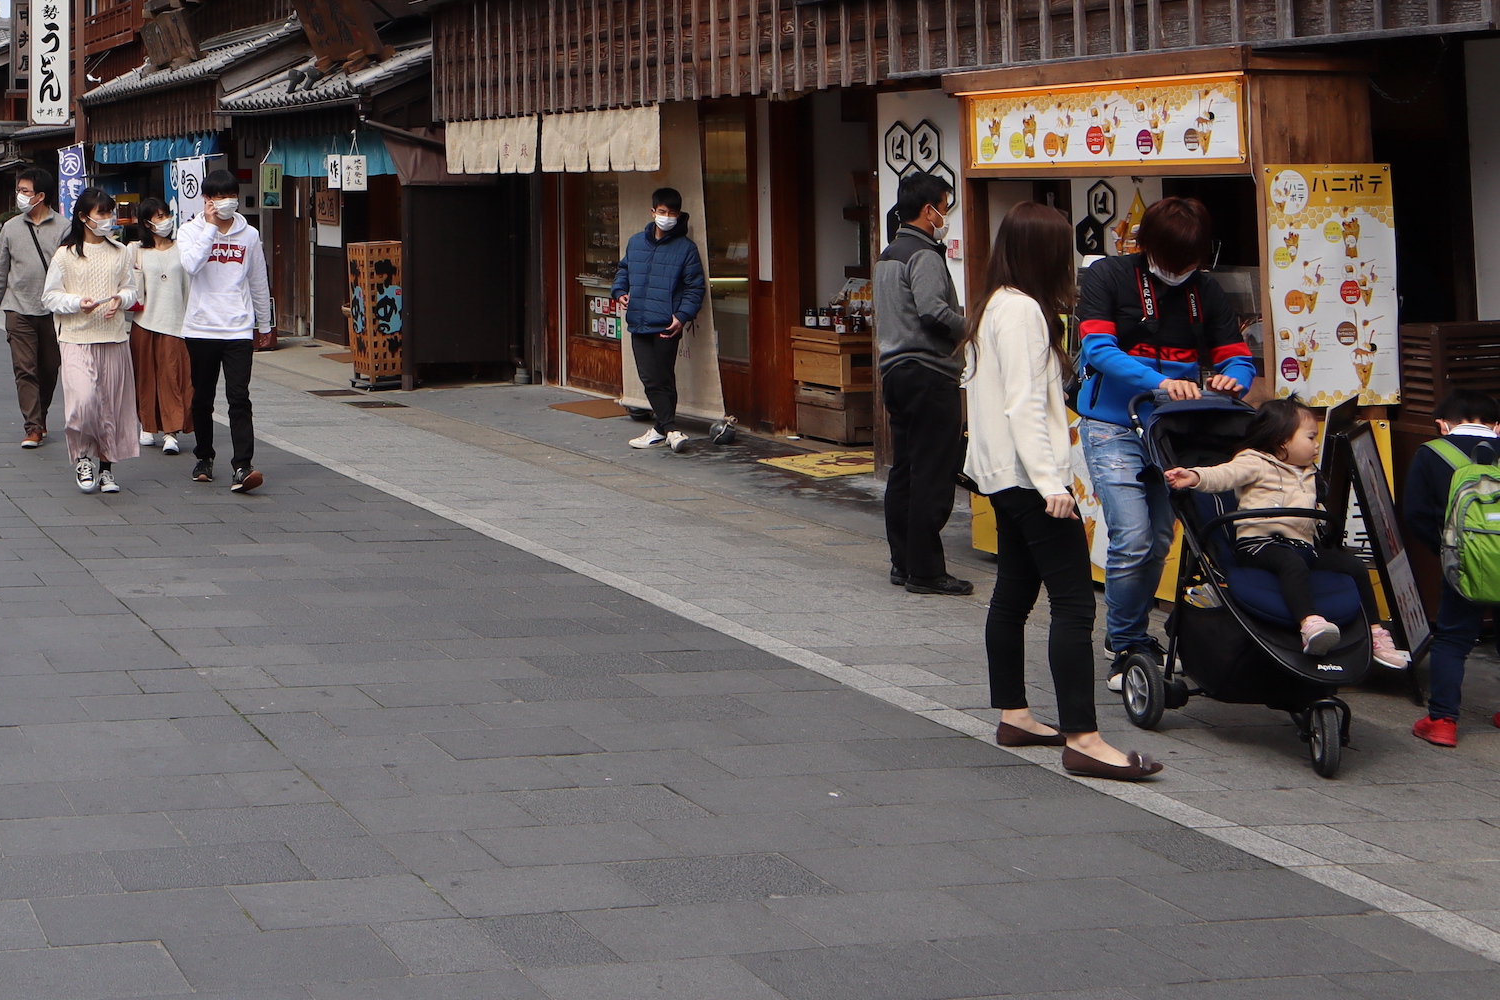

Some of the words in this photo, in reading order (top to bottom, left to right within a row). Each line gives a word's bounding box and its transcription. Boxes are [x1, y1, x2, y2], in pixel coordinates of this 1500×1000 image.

[37, 107, 64, 118] 中井屋
[1312, 174, 1383, 194] ハニポテ
[210, 248, 242, 258] evi's
[1145, 298, 1154, 316] EOS
[1189, 293, 1198, 317] Canon
[678, 347, 691, 359] earl
[1317, 663, 1343, 673] Aprica
